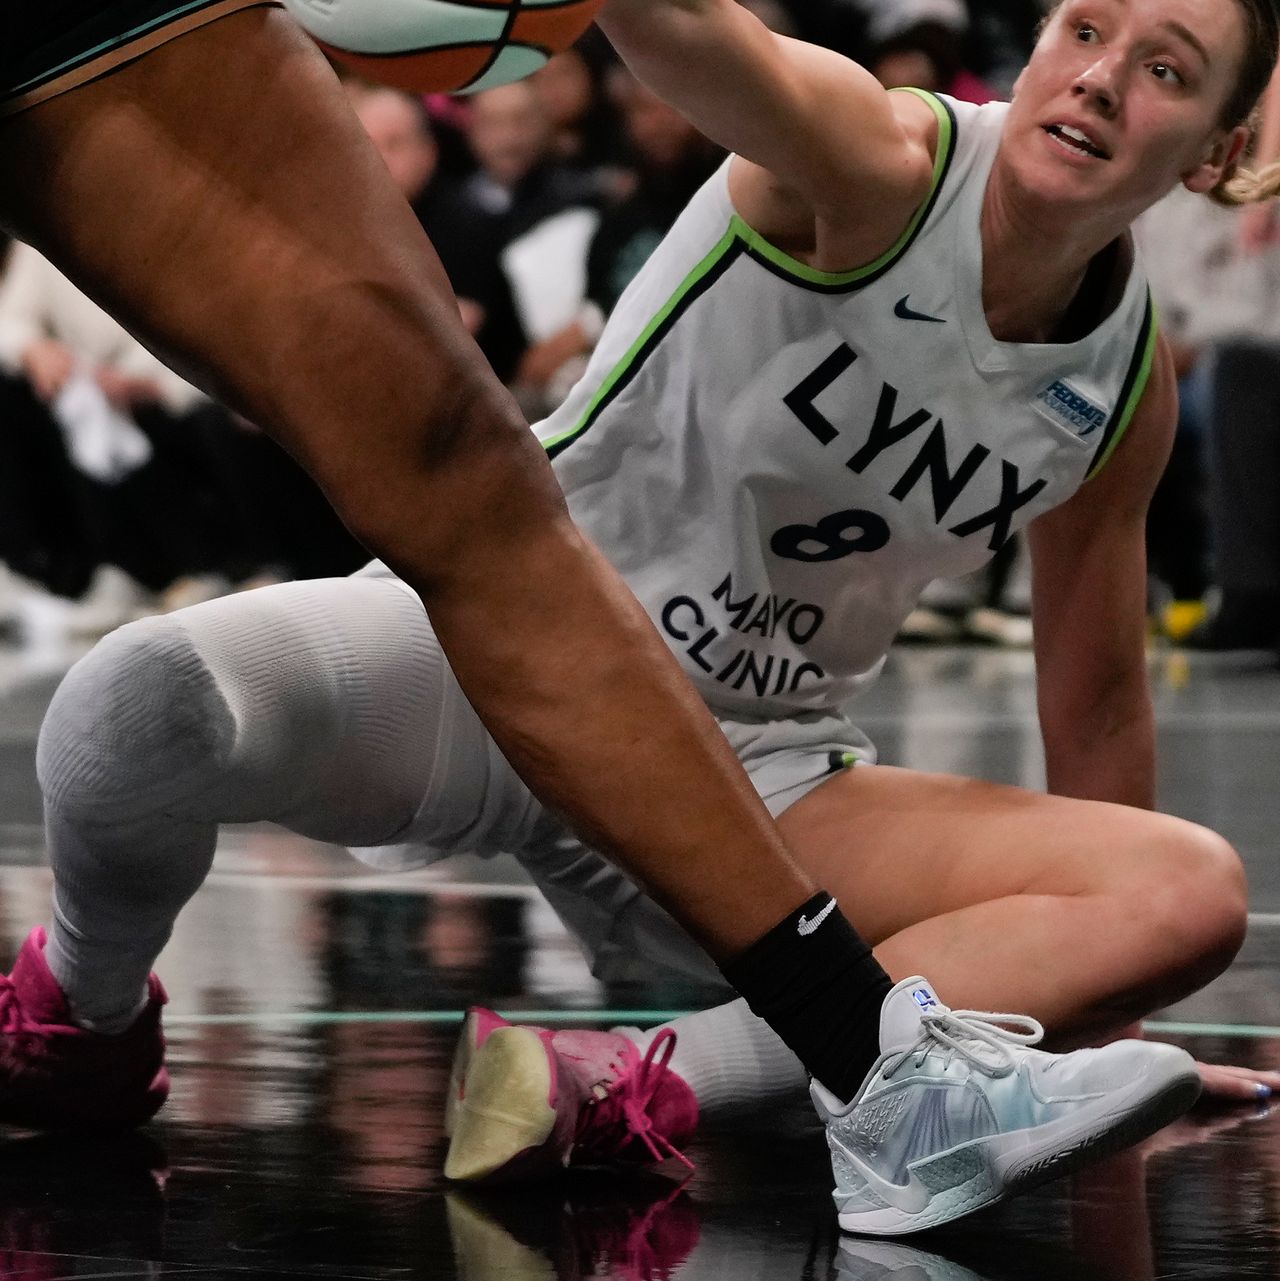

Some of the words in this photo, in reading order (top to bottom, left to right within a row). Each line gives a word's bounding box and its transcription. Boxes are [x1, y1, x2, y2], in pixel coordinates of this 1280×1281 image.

[782, 341, 1049, 551] LYNX
[770, 508, 891, 563] 8
[711, 572, 825, 646] MAYO
